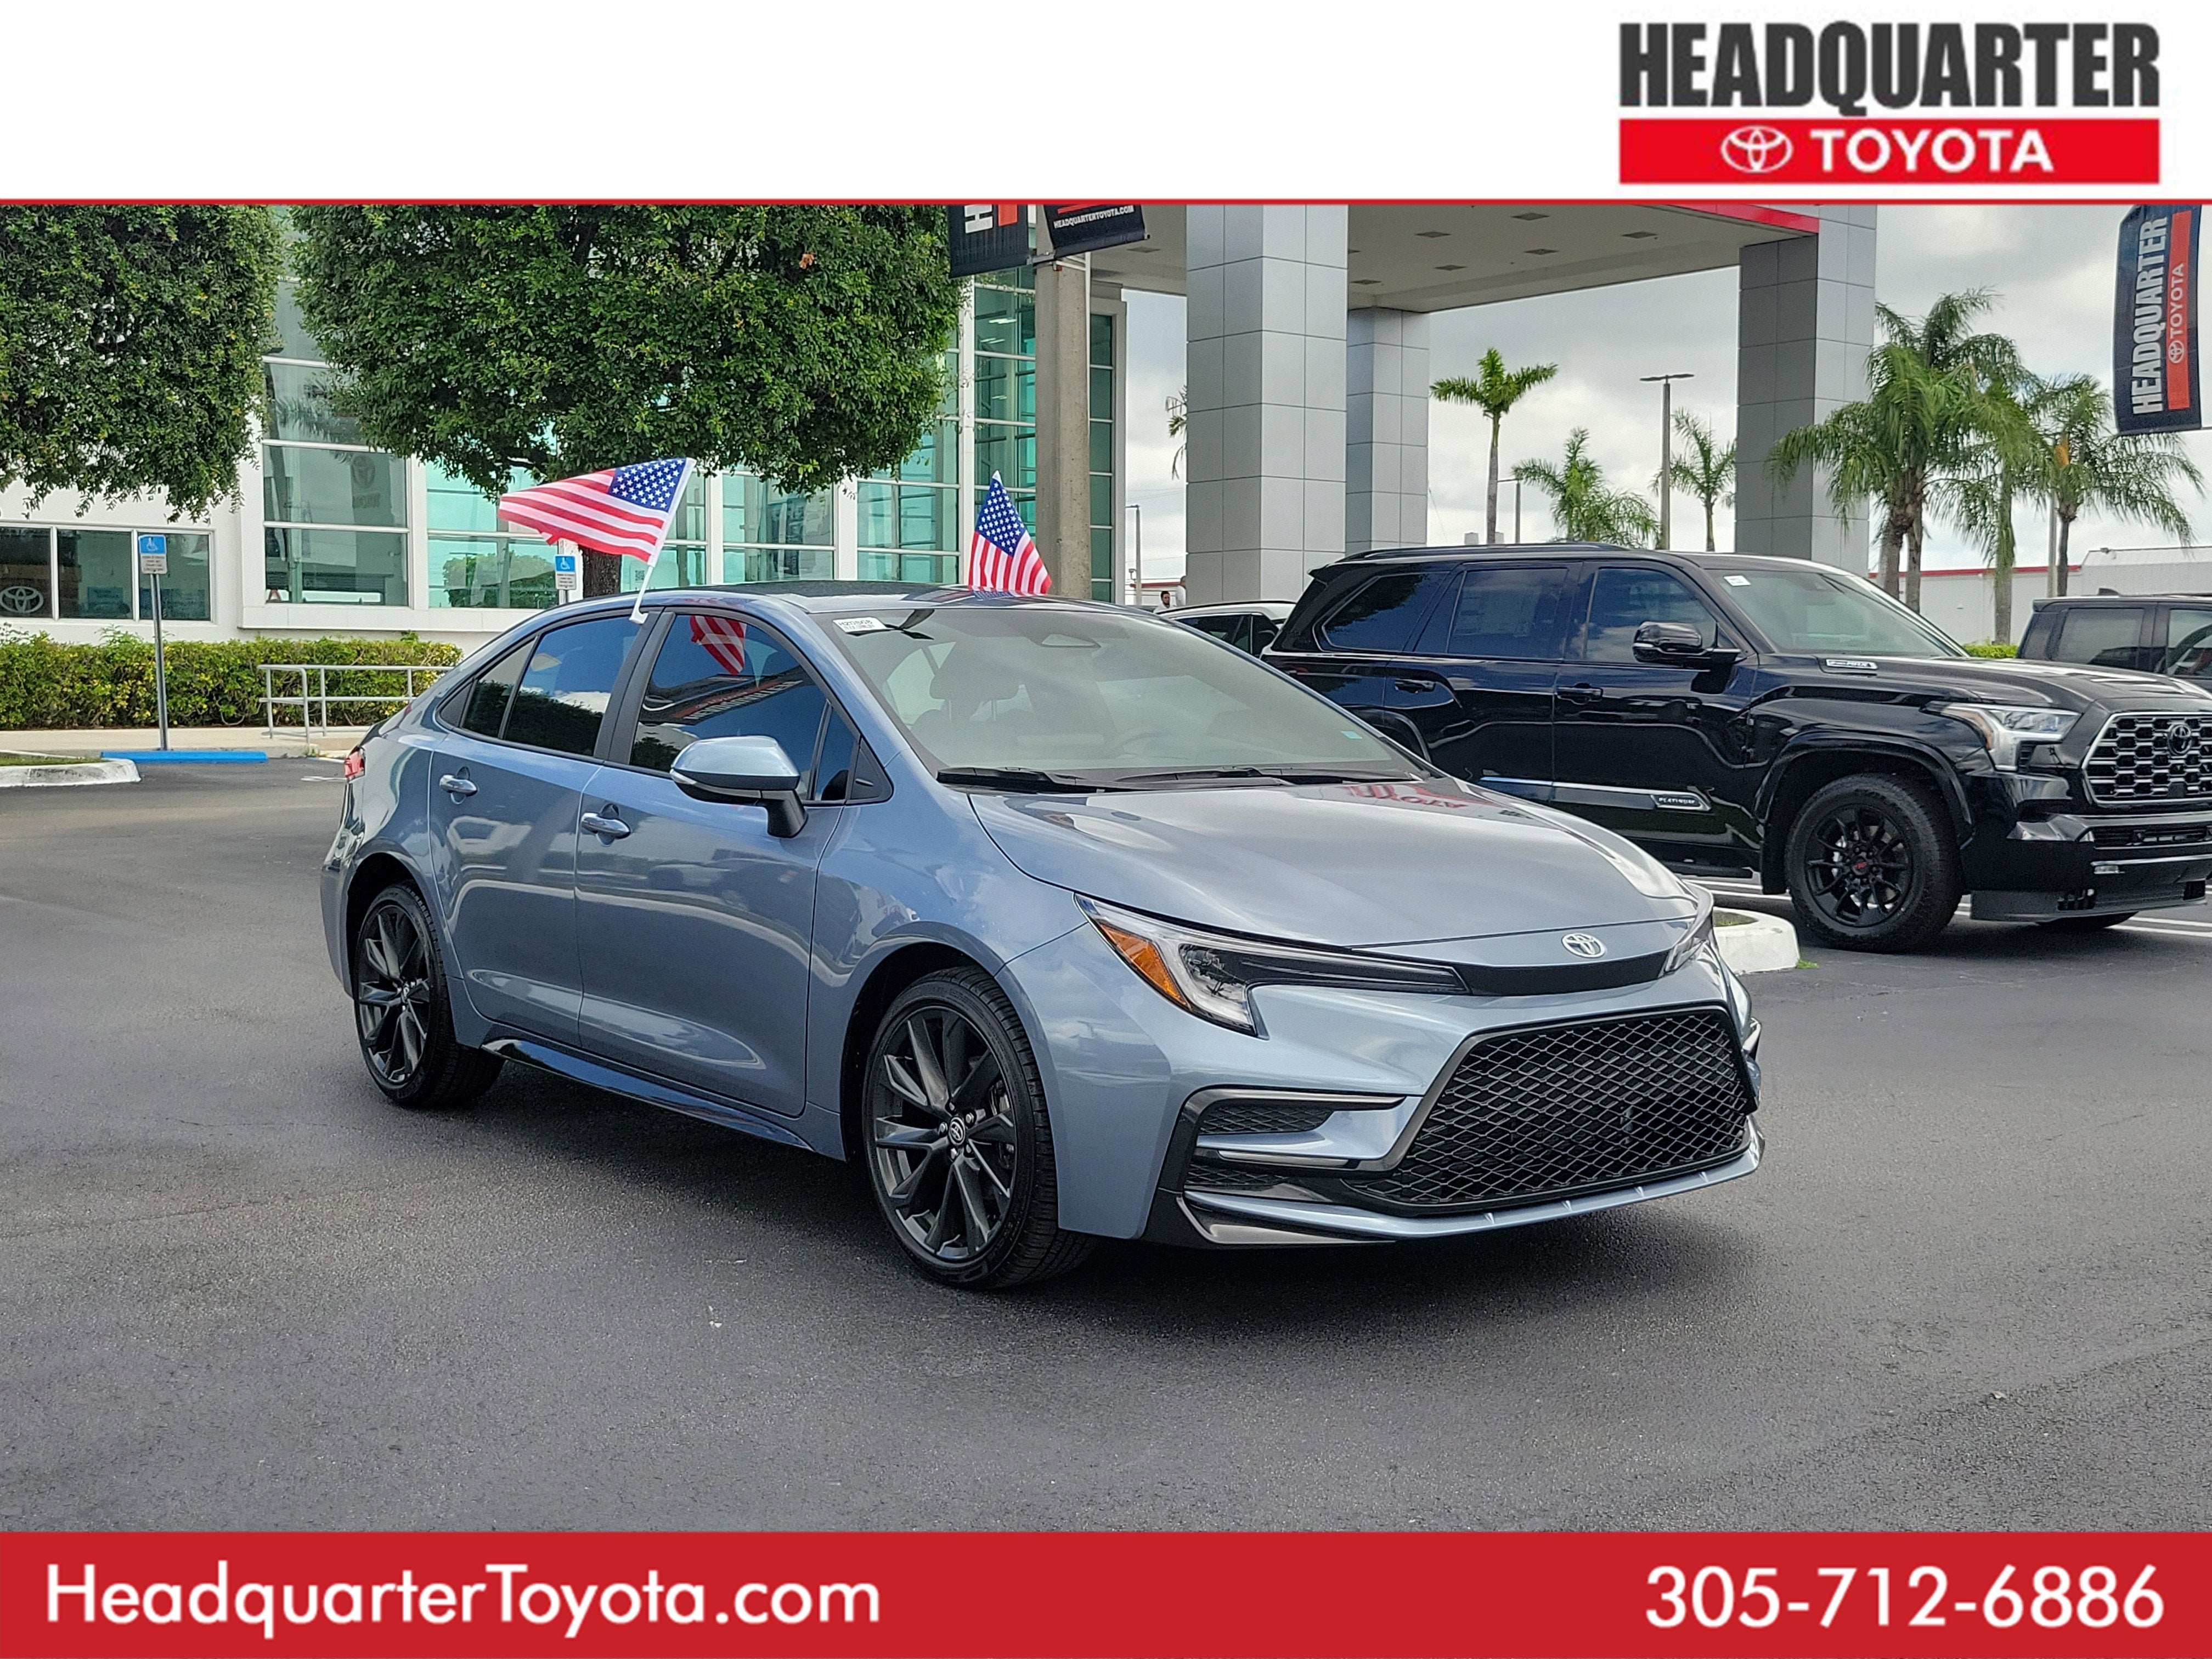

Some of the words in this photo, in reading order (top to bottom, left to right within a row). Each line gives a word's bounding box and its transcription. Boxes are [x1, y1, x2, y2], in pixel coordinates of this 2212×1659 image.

[1053, 205, 1135, 229] HEADQUARTERTOYOTA.COM
[2131, 216, 2168, 414] HEADQUARTER
[2170, 263, 2184, 337] TOYOTA
